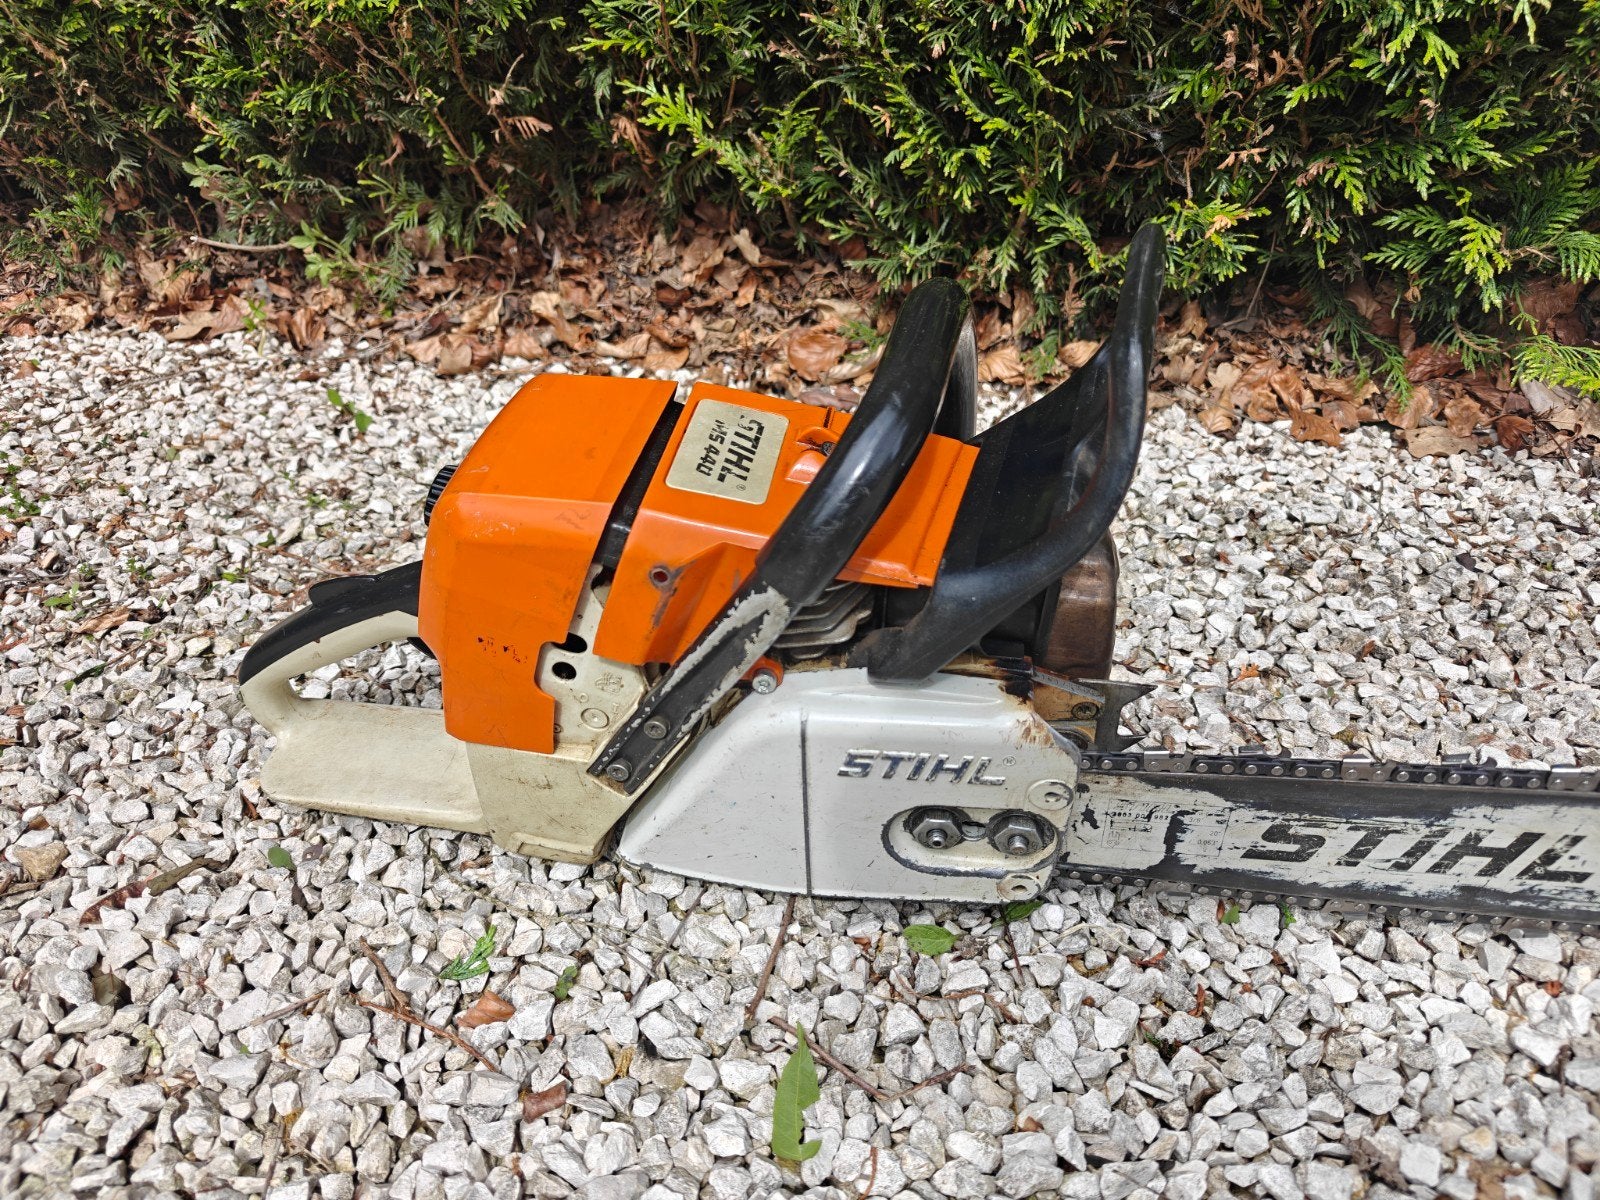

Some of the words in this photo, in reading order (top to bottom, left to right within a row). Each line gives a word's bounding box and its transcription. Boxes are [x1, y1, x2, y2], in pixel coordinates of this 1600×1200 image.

[695, 444, 720, 477] 440
[717, 414, 765, 483] STIHL
[837, 748, 1007, 786] STIHL
[1240, 822, 1595, 884] STIHL
